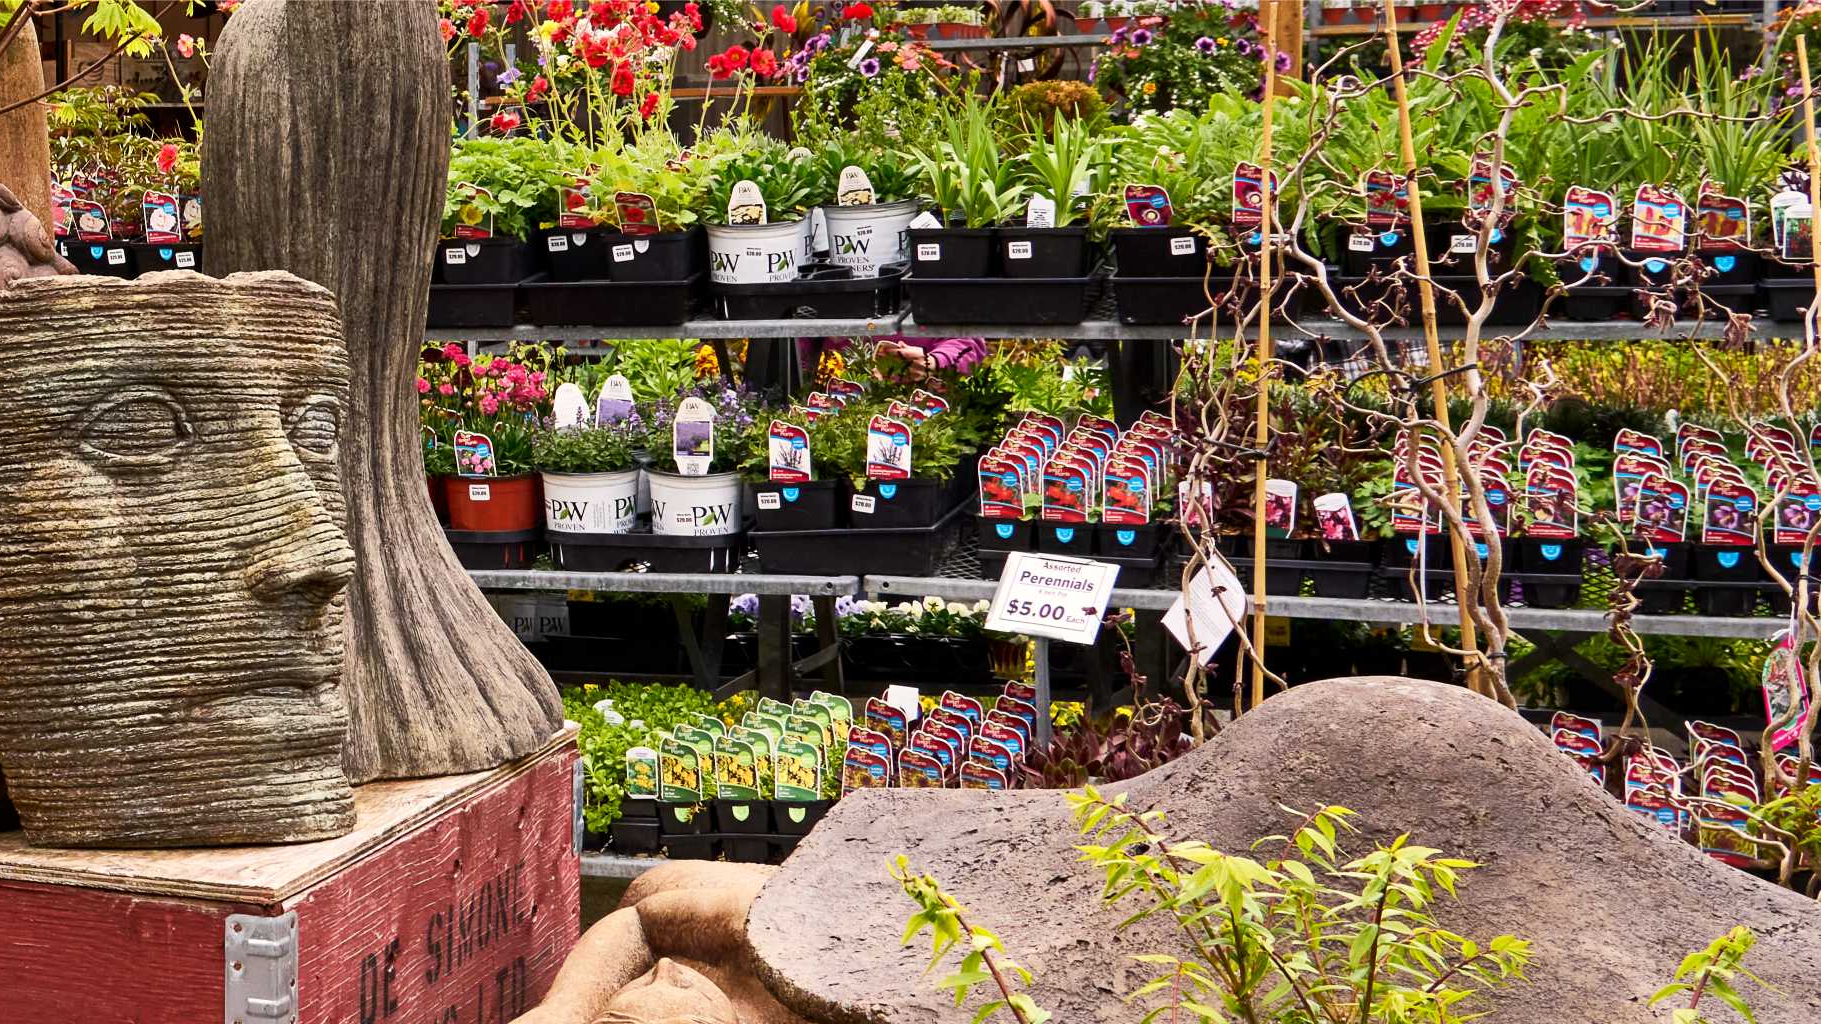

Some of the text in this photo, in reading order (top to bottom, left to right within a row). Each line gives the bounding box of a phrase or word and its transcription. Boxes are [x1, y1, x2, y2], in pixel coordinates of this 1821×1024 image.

[834, 234, 870, 255] PW
[551, 499, 588, 521] PW
[691, 503, 732, 527] PW
[1043, 562, 1082, 574] Assorted
[1019, 570, 1095, 592] Perennials
[1006, 598, 1065, 621] $5.00
[425, 864, 526, 985] SIMONE
